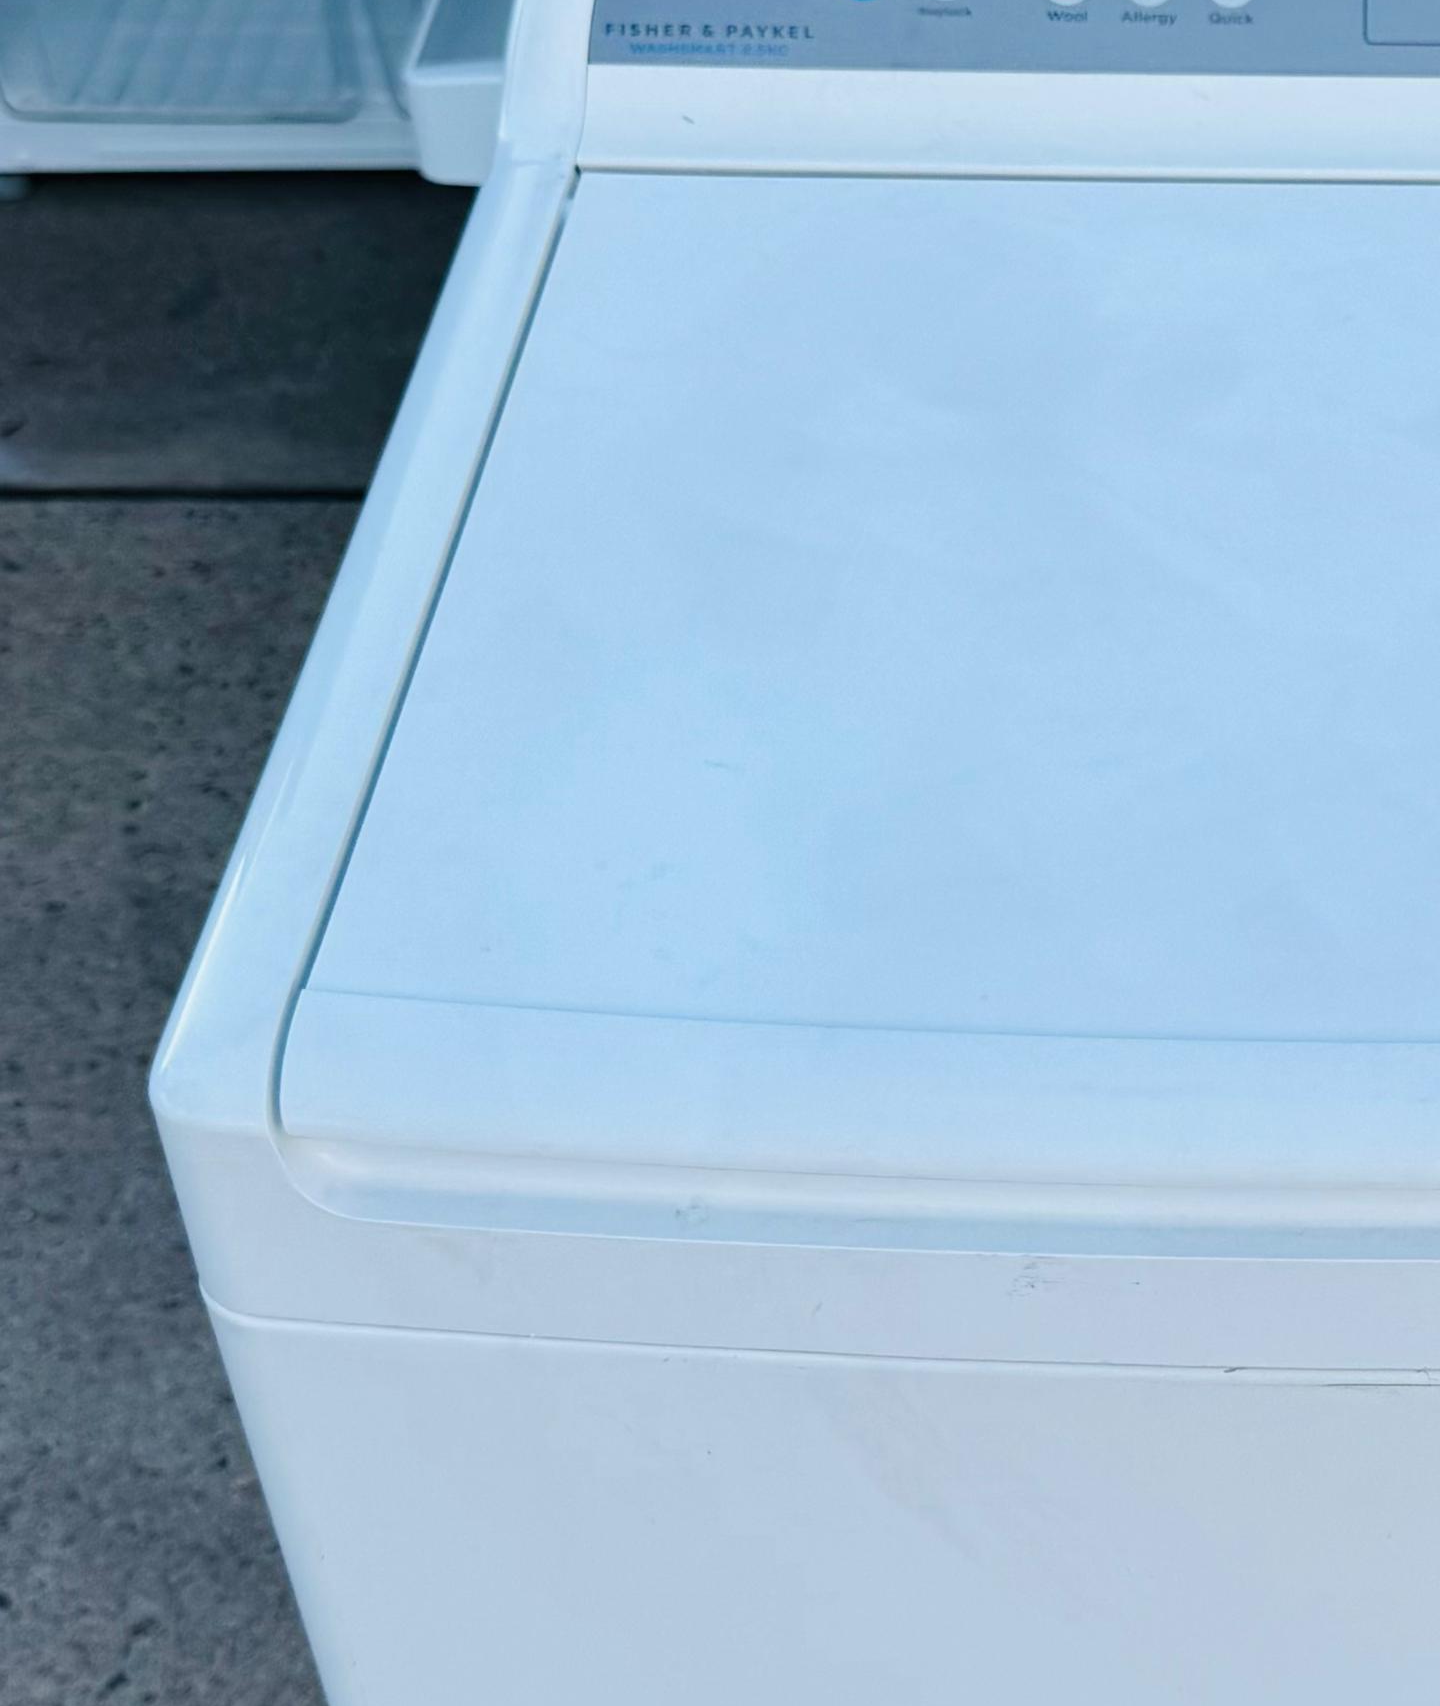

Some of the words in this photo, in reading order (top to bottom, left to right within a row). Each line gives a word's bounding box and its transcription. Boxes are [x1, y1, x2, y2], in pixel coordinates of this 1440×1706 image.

[1047, 10, 1088, 22] Wool
[1121, 10, 1177, 26] Allergy
[1208, 12, 1253, 25] Quick
[605, 23, 693, 38] FISHER
[703, 24, 715, 38] &
[726, 24, 815, 39] PAYKEL
